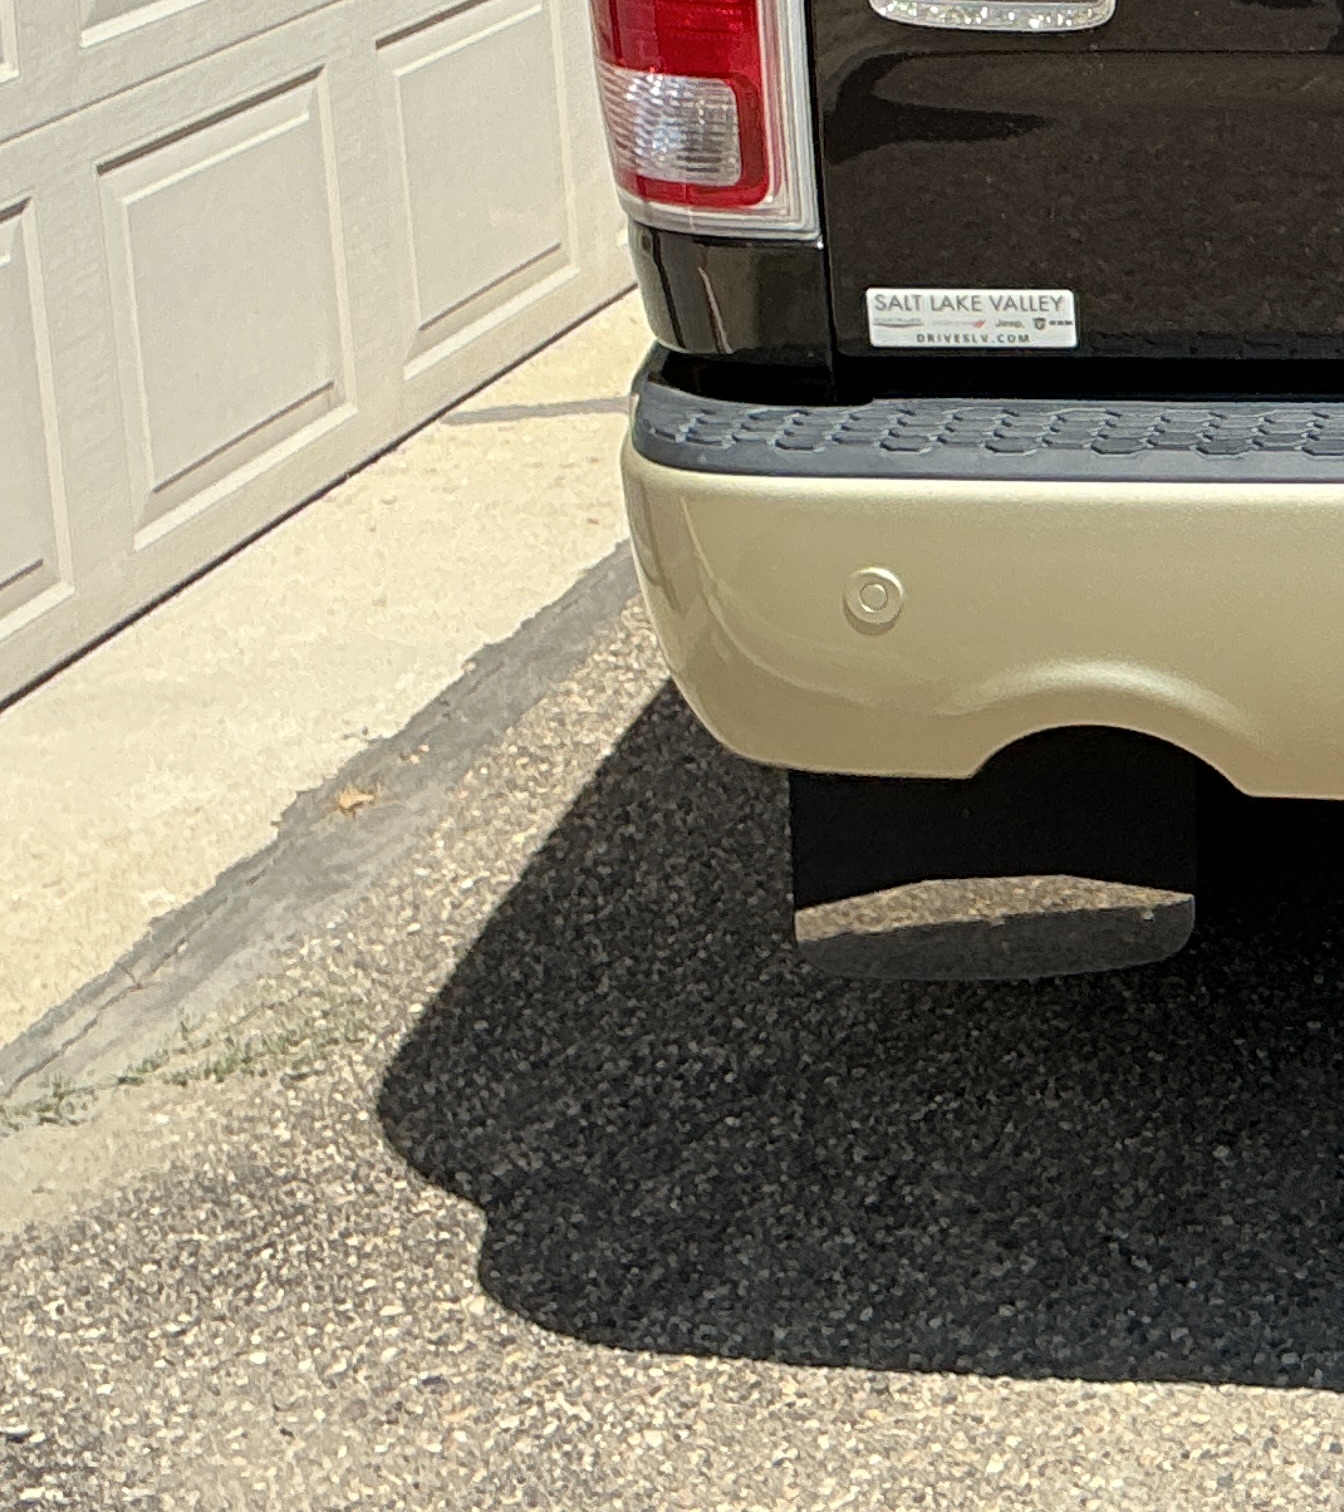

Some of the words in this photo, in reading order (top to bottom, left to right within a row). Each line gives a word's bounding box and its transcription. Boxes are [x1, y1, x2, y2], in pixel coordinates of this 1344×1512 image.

[874, 294, 923, 312] SALT
[930, 295, 982, 312] LAKE
[989, 294, 1065, 312] VALLEY
